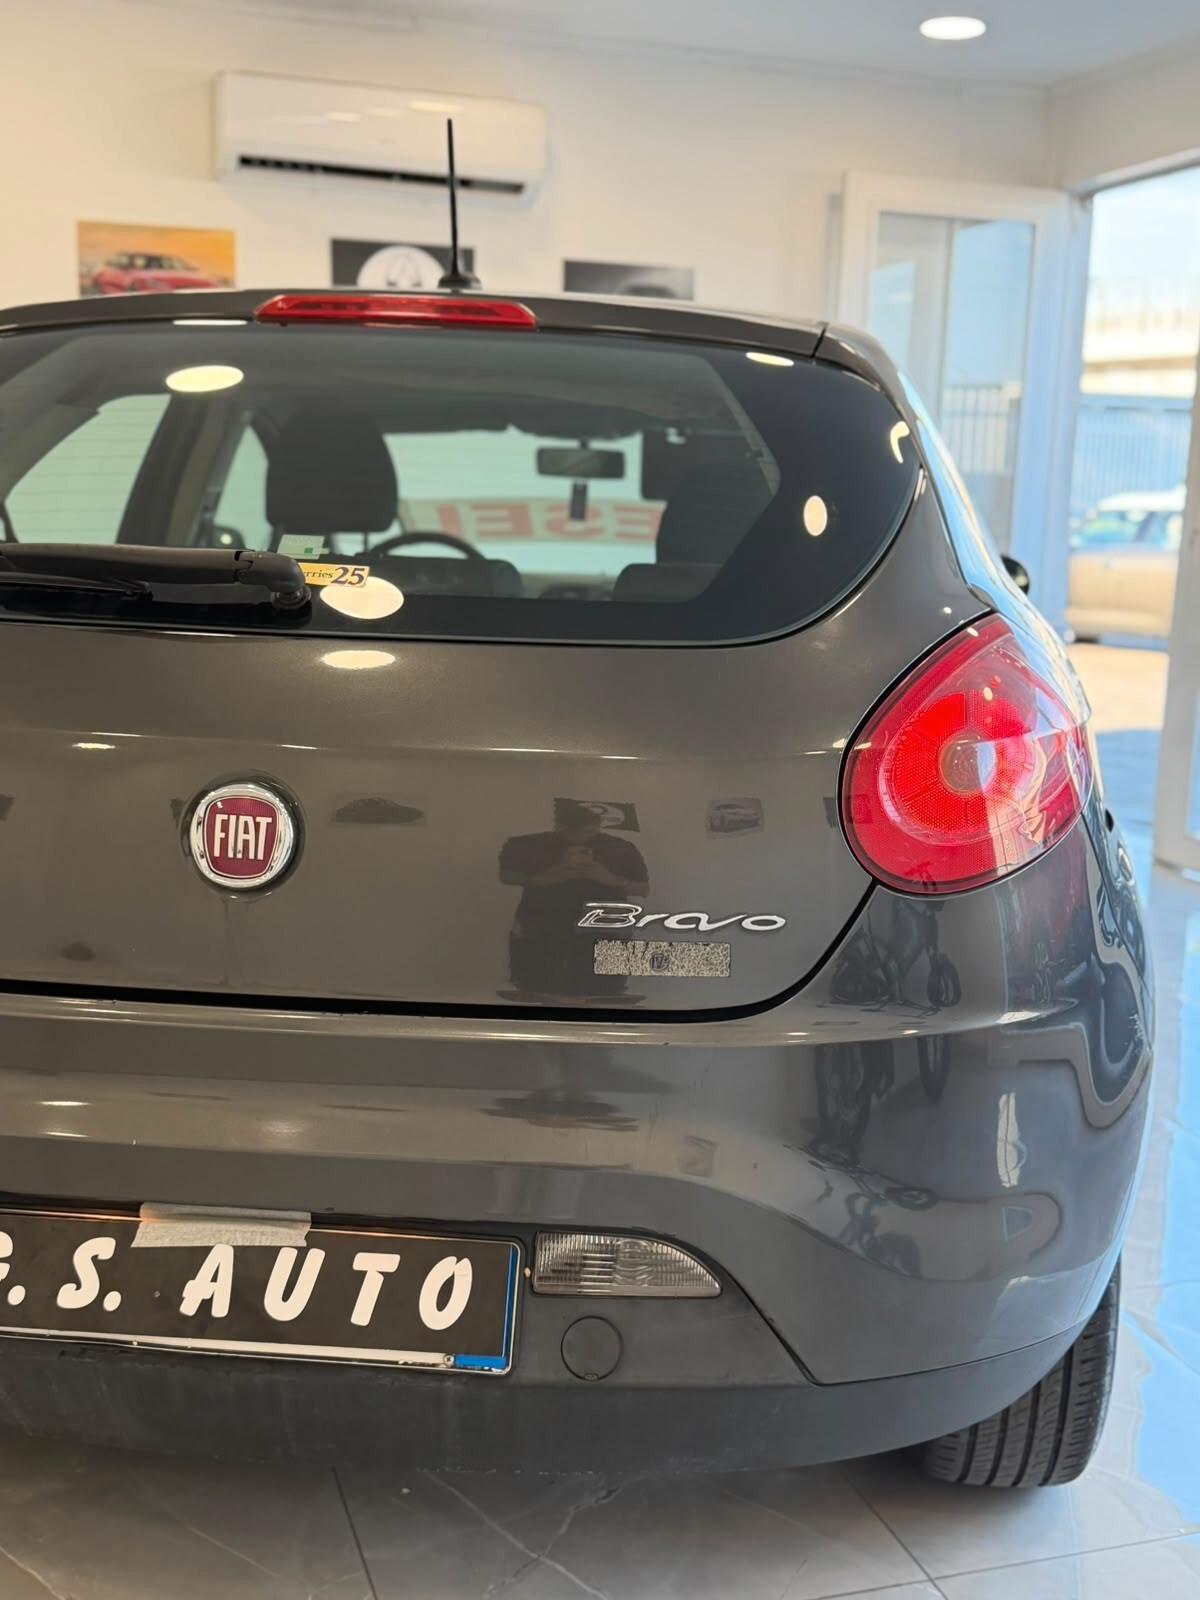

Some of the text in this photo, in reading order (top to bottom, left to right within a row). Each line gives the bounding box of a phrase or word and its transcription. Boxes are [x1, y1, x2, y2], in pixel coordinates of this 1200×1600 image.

[331, 567, 365, 585] 25
[213, 813, 272, 860] FIAT
[577, 902, 786, 931] Bravo
[179, 1243, 473, 1331] AUTO
